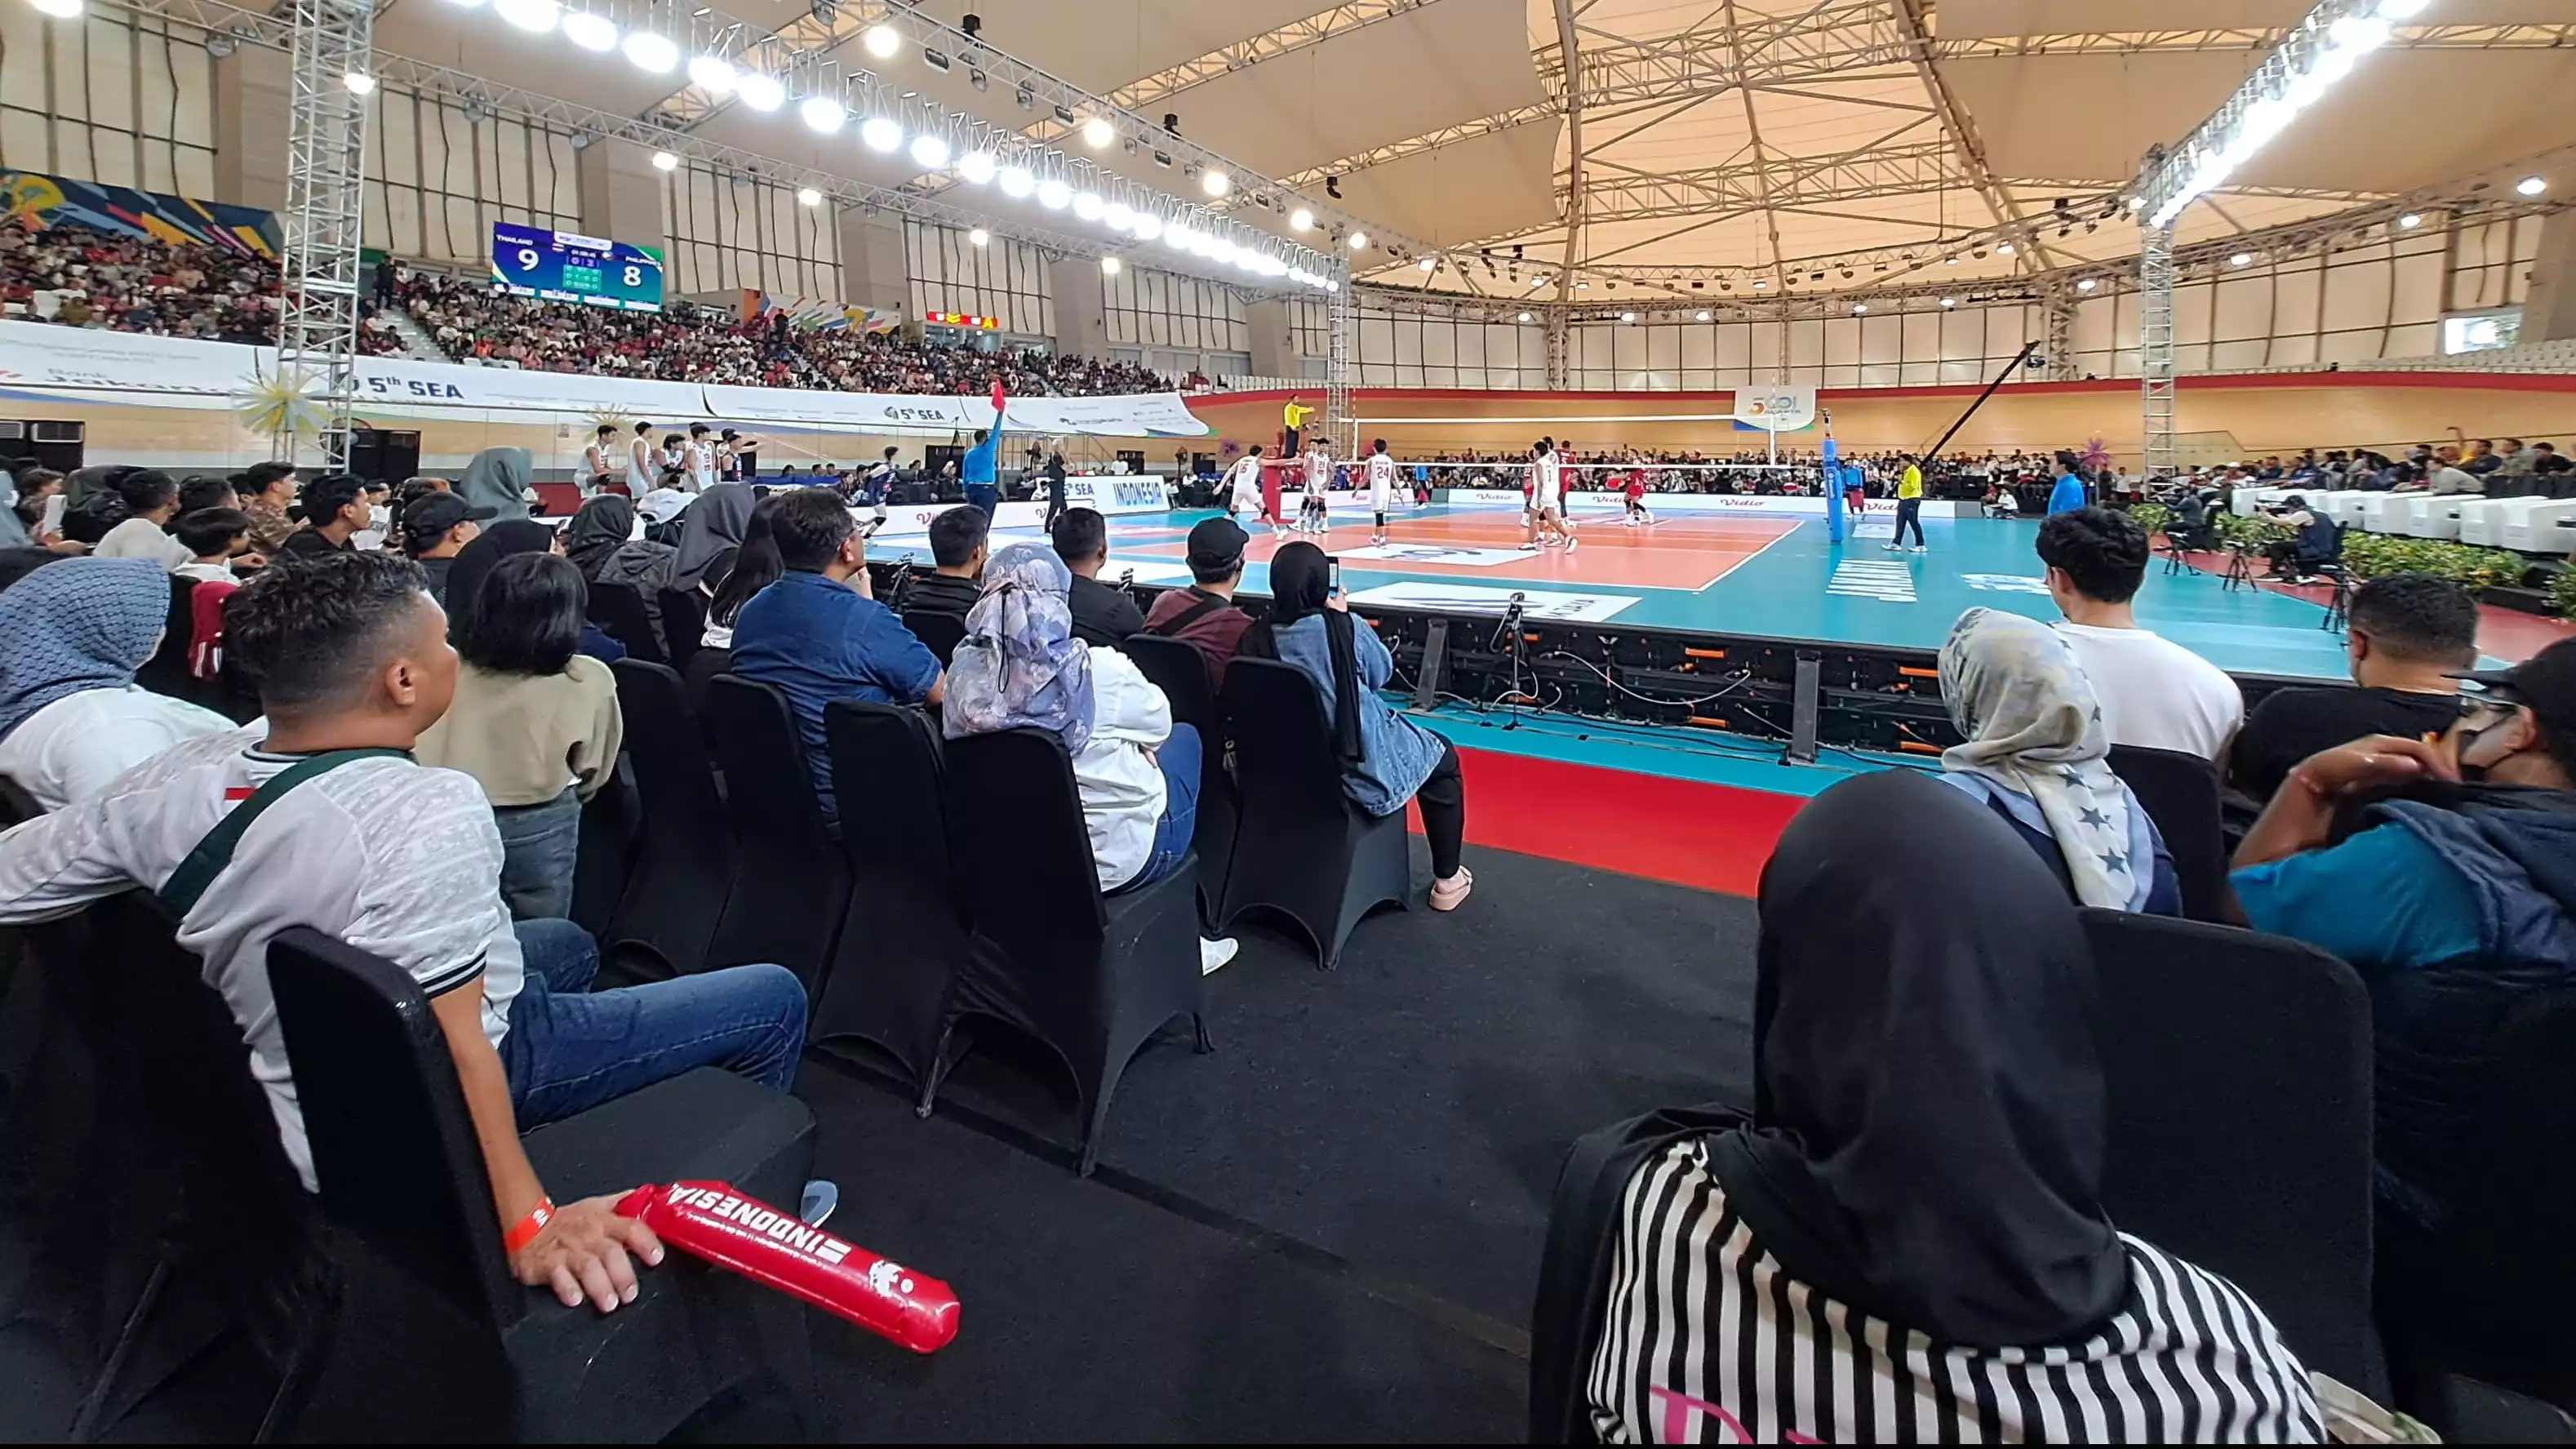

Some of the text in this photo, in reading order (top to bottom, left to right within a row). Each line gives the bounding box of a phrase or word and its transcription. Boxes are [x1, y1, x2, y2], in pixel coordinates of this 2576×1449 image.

[496, 234, 533, 246] THAILAND
[517, 249, 539, 271] 9
[623, 265, 642, 287] 8
[368, 376, 402, 393] 5th
[408, 380, 465, 399] SEA
[917, 410, 945, 420] SEA
[1377, 466, 1389, 479] 24
[1075, 482, 1095, 496] SEA
[1113, 482, 1164, 507] INDONESIA
[1720, 498, 1765, 507] Vidio
[667, 1183, 824, 1256] INDONESIA
